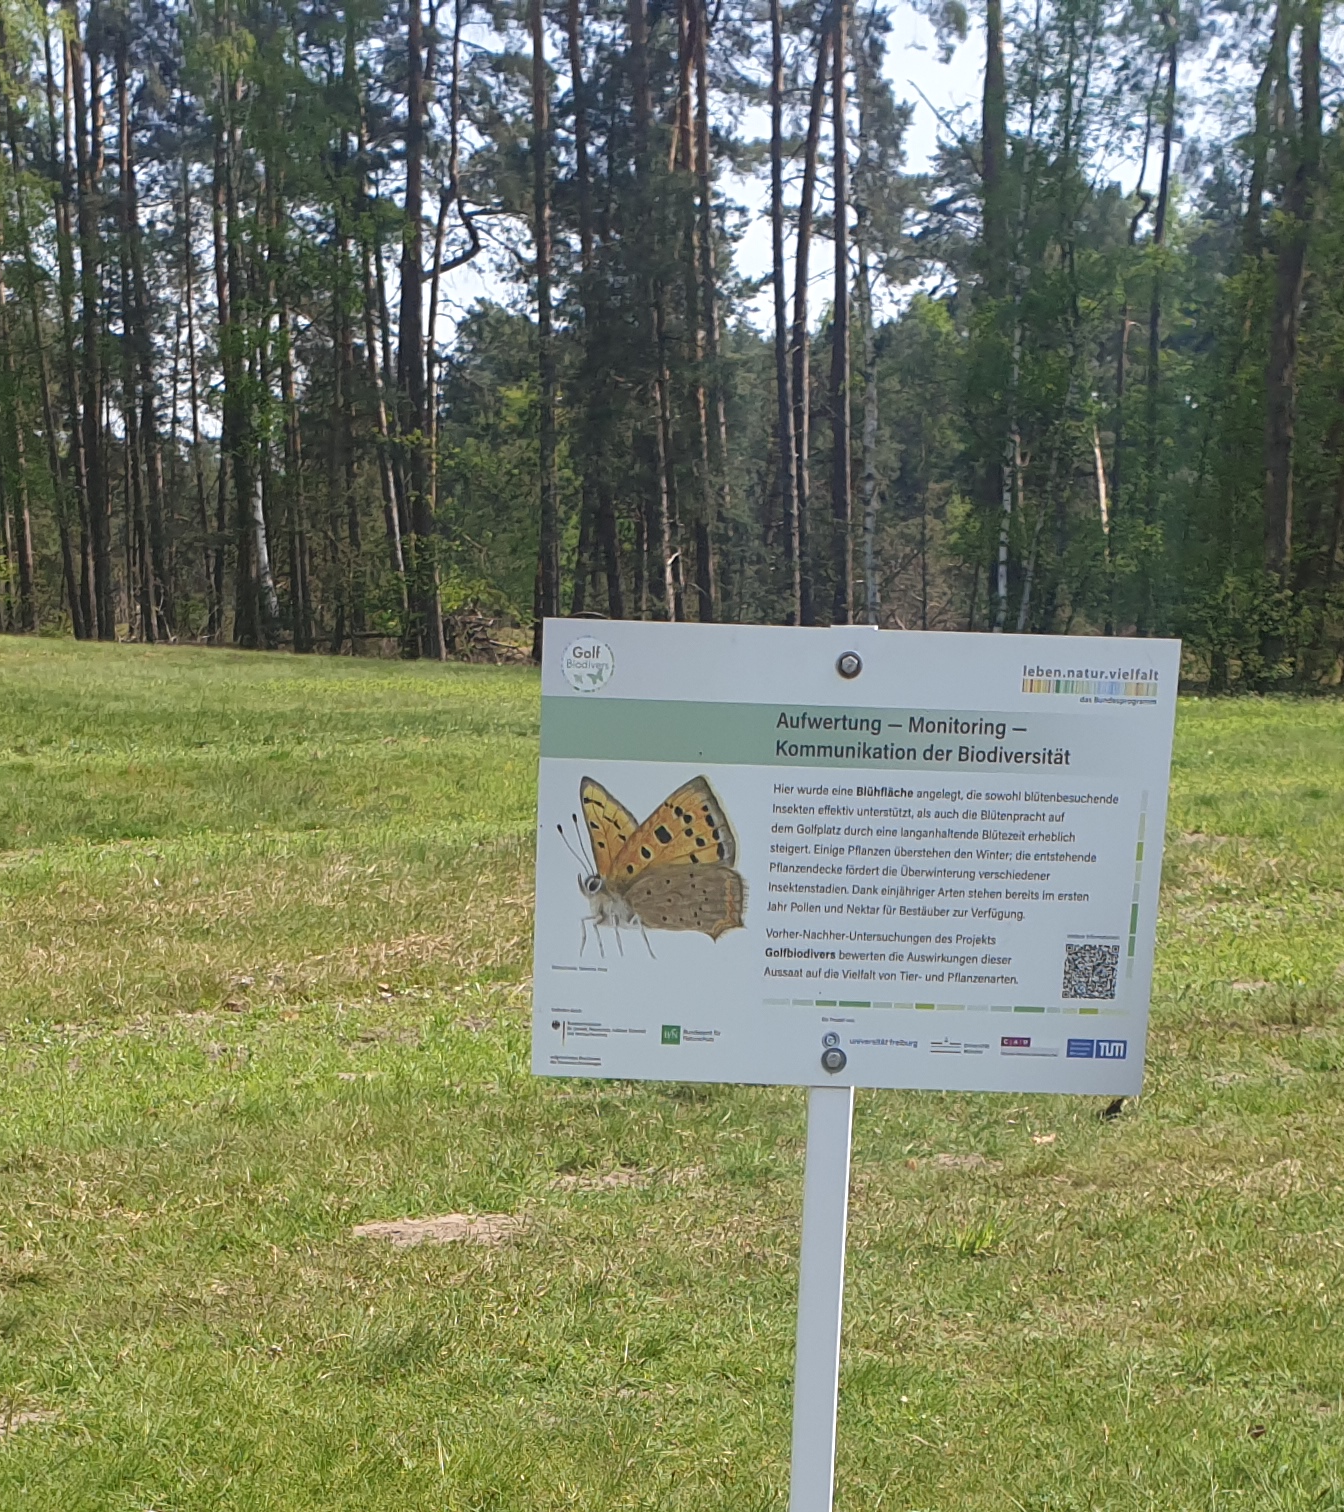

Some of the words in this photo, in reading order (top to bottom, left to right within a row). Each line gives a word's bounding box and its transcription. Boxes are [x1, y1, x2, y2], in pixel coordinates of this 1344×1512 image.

[573, 646, 601, 659] Golf
[567, 658, 609, 670] Biodivers
[1023, 665, 1159, 681] leben.natur.vielfalt
[776, 711, 881, 735] Aufwertung
[908, 716, 1005, 739] Monitoring
[776, 740, 916, 761] Kommunikation
[922, 743, 952, 761] der
[958, 745, 1070, 764] Biodiversität
[773, 783, 794, 794] Hier
[797, 784, 828, 795] wurde
[831, 785, 853, 796] eine
[856, 785, 913, 797] Blühfläche
[916, 788, 963, 802] angelegt,
[966, 789, 982, 799] die
[985, 790, 1021, 800] sowohl
[1024, 791, 1118, 804] blütenbesuchende
[772, 803, 814, 814] Insekten
[818, 804, 854, 815] effektiv
[916, 807, 931, 818] als
[934, 808, 958, 818] auch
[962, 809, 977, 819] die
[980, 809, 1045, 823] Blütenpracht
[1048, 812, 1065, 822] auf
[771, 822, 793, 833] dem
[797, 823, 841, 836] Golfplatz
[844, 825, 873, 836] durch
[876, 826, 897, 837] eine
[901, 827, 978, 840] langanhaltende
[982, 829, 1025, 840] Blütezeit
[1028, 830, 1075, 842] erheblich
[813, 843, 844, 857] Einige
[847, 845, 890, 856] Pflanzen
[894, 846, 950, 858] überstehen
[954, 848, 972, 858] den
[1015, 850, 1031, 860] die
[1033, 851, 1096, 862] entstehende
[769, 861, 842, 874] Pflanzendecke
[845, 864, 879, 875] fördert
[882, 865, 897, 876] die
[900, 864, 975, 881] Überwinterung
[978, 869, 1050, 880] verschiedener
[852, 884, 878, 894] Dank
[881, 885, 935, 899] einjähriger
[937, 887, 964, 897] Arten
[967, 888, 1001, 898] stehen
[1005, 888, 1039, 900] bereits
[1042, 889, 1054, 900] im
[1057, 891, 1089, 901] ersten
[767, 901, 787, 911] Jahr
[790, 901, 820, 913] Pollen
[824, 903, 843, 913] und
[846, 904, 879, 914] Nektar
[882, 904, 896, 915] für
[899, 905, 949, 916] Bestäuber
[952, 909, 968, 917] zur
[766, 928, 931, 946] Vorher-Nachher-Untersuchungen
[935, 933, 952, 943] des
[955, 934, 996, 947] Projekts
[765, 947, 835, 959] Golfbiodivers
[838, 949, 885, 960] bewerten
[888, 951, 903, 961] die
[906, 951, 977, 966] Auswirkungen
[980, 954, 1011, 964] dieser
[763, 966, 802, 977] Aussaat
[805, 967, 821, 978] auf
[824, 968, 839, 978] die
[841, 969, 875, 980] Vielfalt
[878, 972, 896, 980] von
[899, 971, 922, 981] Tier-
[925, 971, 944, 982] und
[1098, 1042, 1124, 1057] TUM
